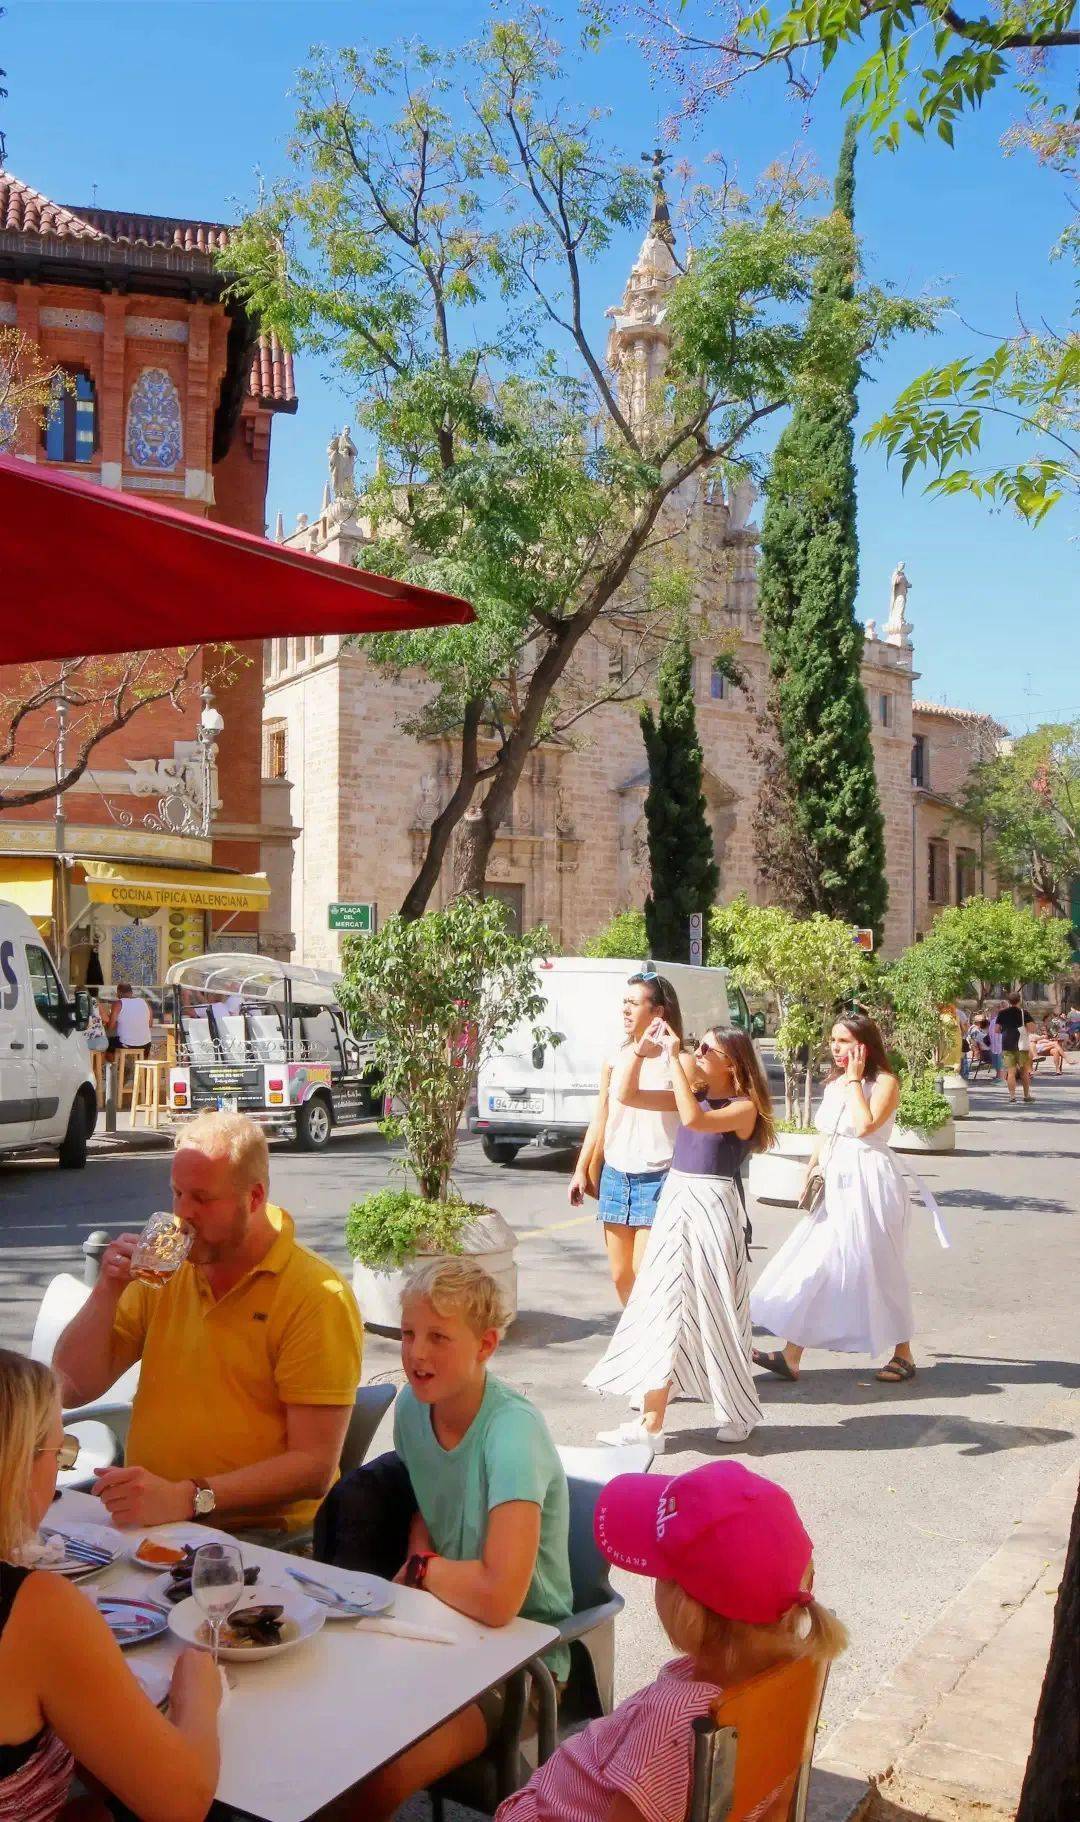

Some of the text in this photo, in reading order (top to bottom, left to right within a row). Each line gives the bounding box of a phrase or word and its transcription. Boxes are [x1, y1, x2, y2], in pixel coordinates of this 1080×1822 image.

[111, 887, 249, 908] COCINA TÍPICA VALENCIANA
[340, 907, 361, 915] PLAÇA
[599, 1506, 648, 1567] DEUTSCHLAND
